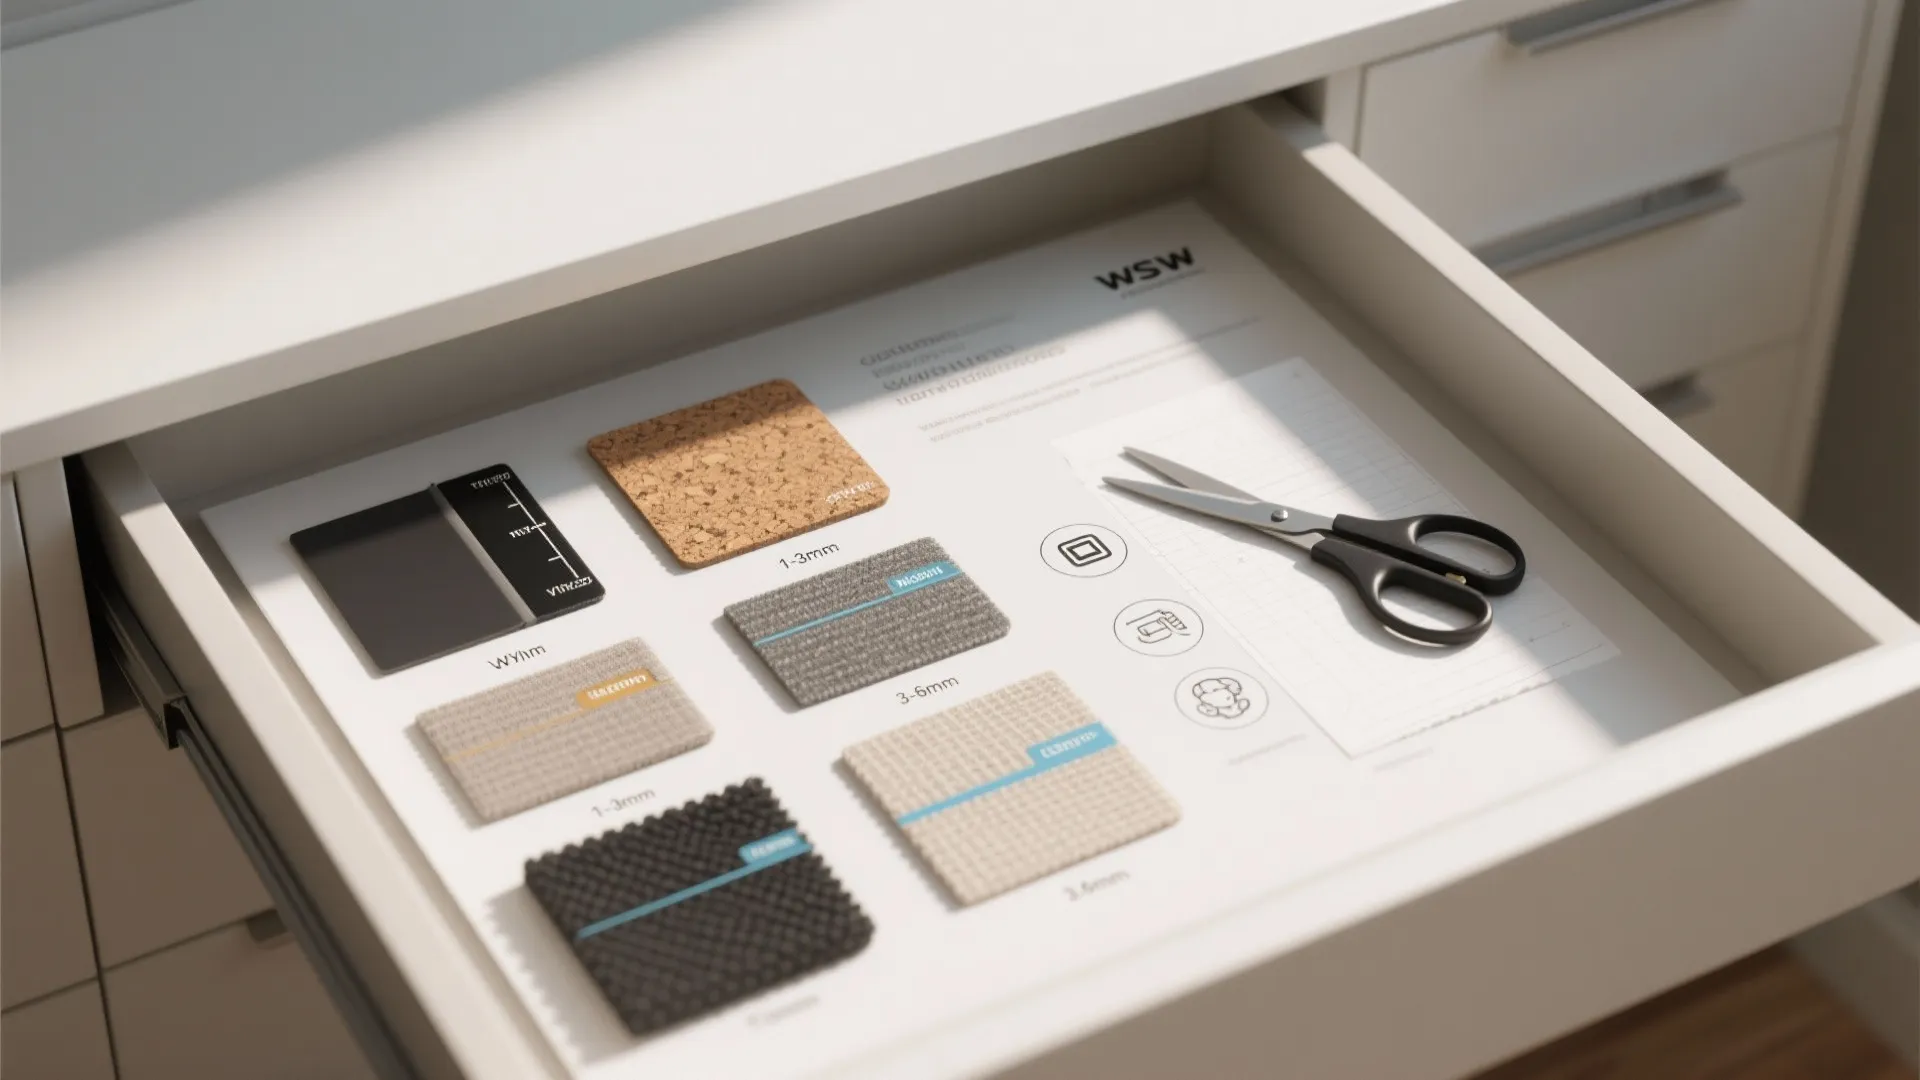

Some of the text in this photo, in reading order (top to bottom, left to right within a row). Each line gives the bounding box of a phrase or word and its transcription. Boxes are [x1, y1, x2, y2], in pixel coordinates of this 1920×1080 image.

[1094, 246, 1194, 290] WSW
[779, 543, 839, 569] 1-3mm
[896, 675, 959, 705] 3-6mm
